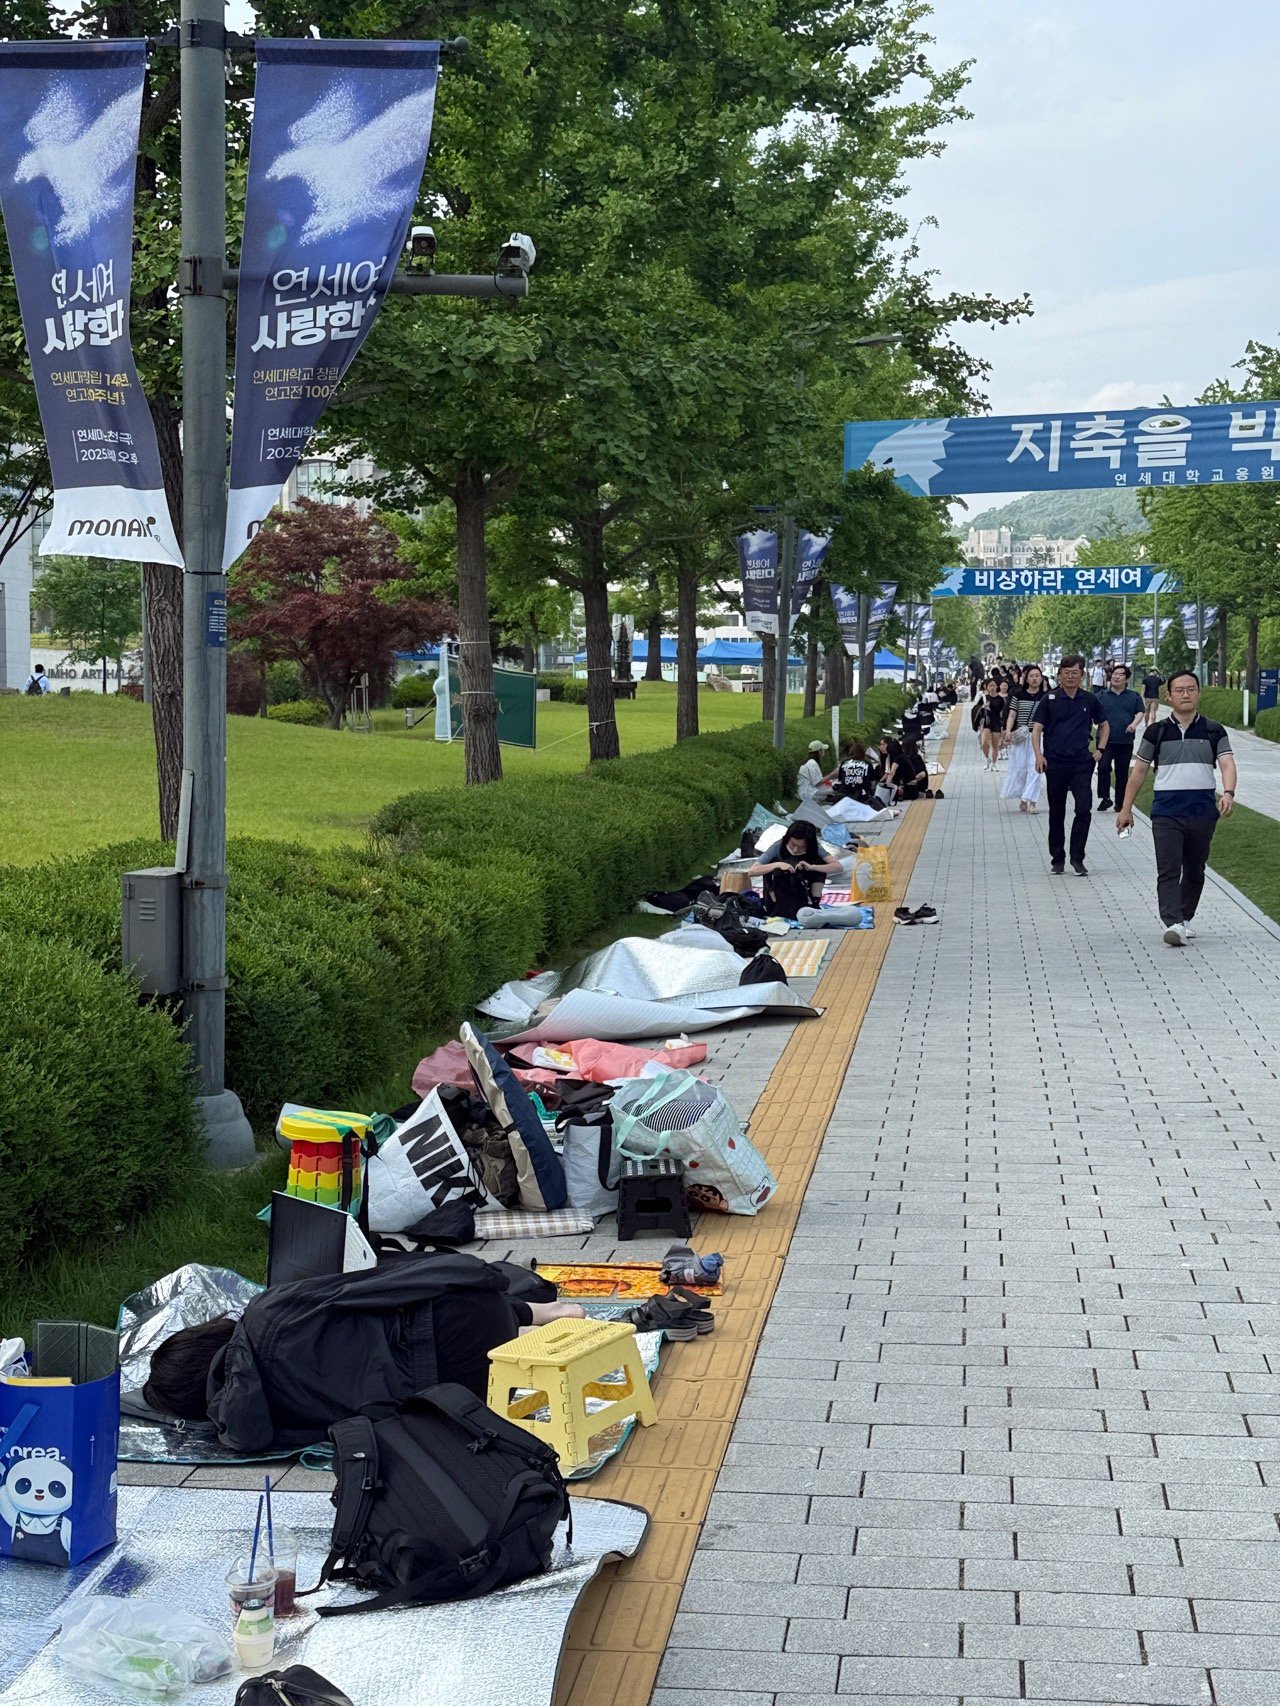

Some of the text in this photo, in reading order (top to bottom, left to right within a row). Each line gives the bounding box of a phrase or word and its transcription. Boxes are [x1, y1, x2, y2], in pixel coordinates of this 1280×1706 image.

[251, 291, 376, 353] 사랑한
[253, 367, 339, 384] 연세대학교 창립
[265, 386, 302, 401] 연고전
[1006, 415, 1192, 472] 지축을
[974, 567, 1142, 591] 비상하라 연세여
[80, 668, 103, 680] ART
[398, 1114, 488, 1210] NIK
[5, 1445, 66, 1461] orea.
